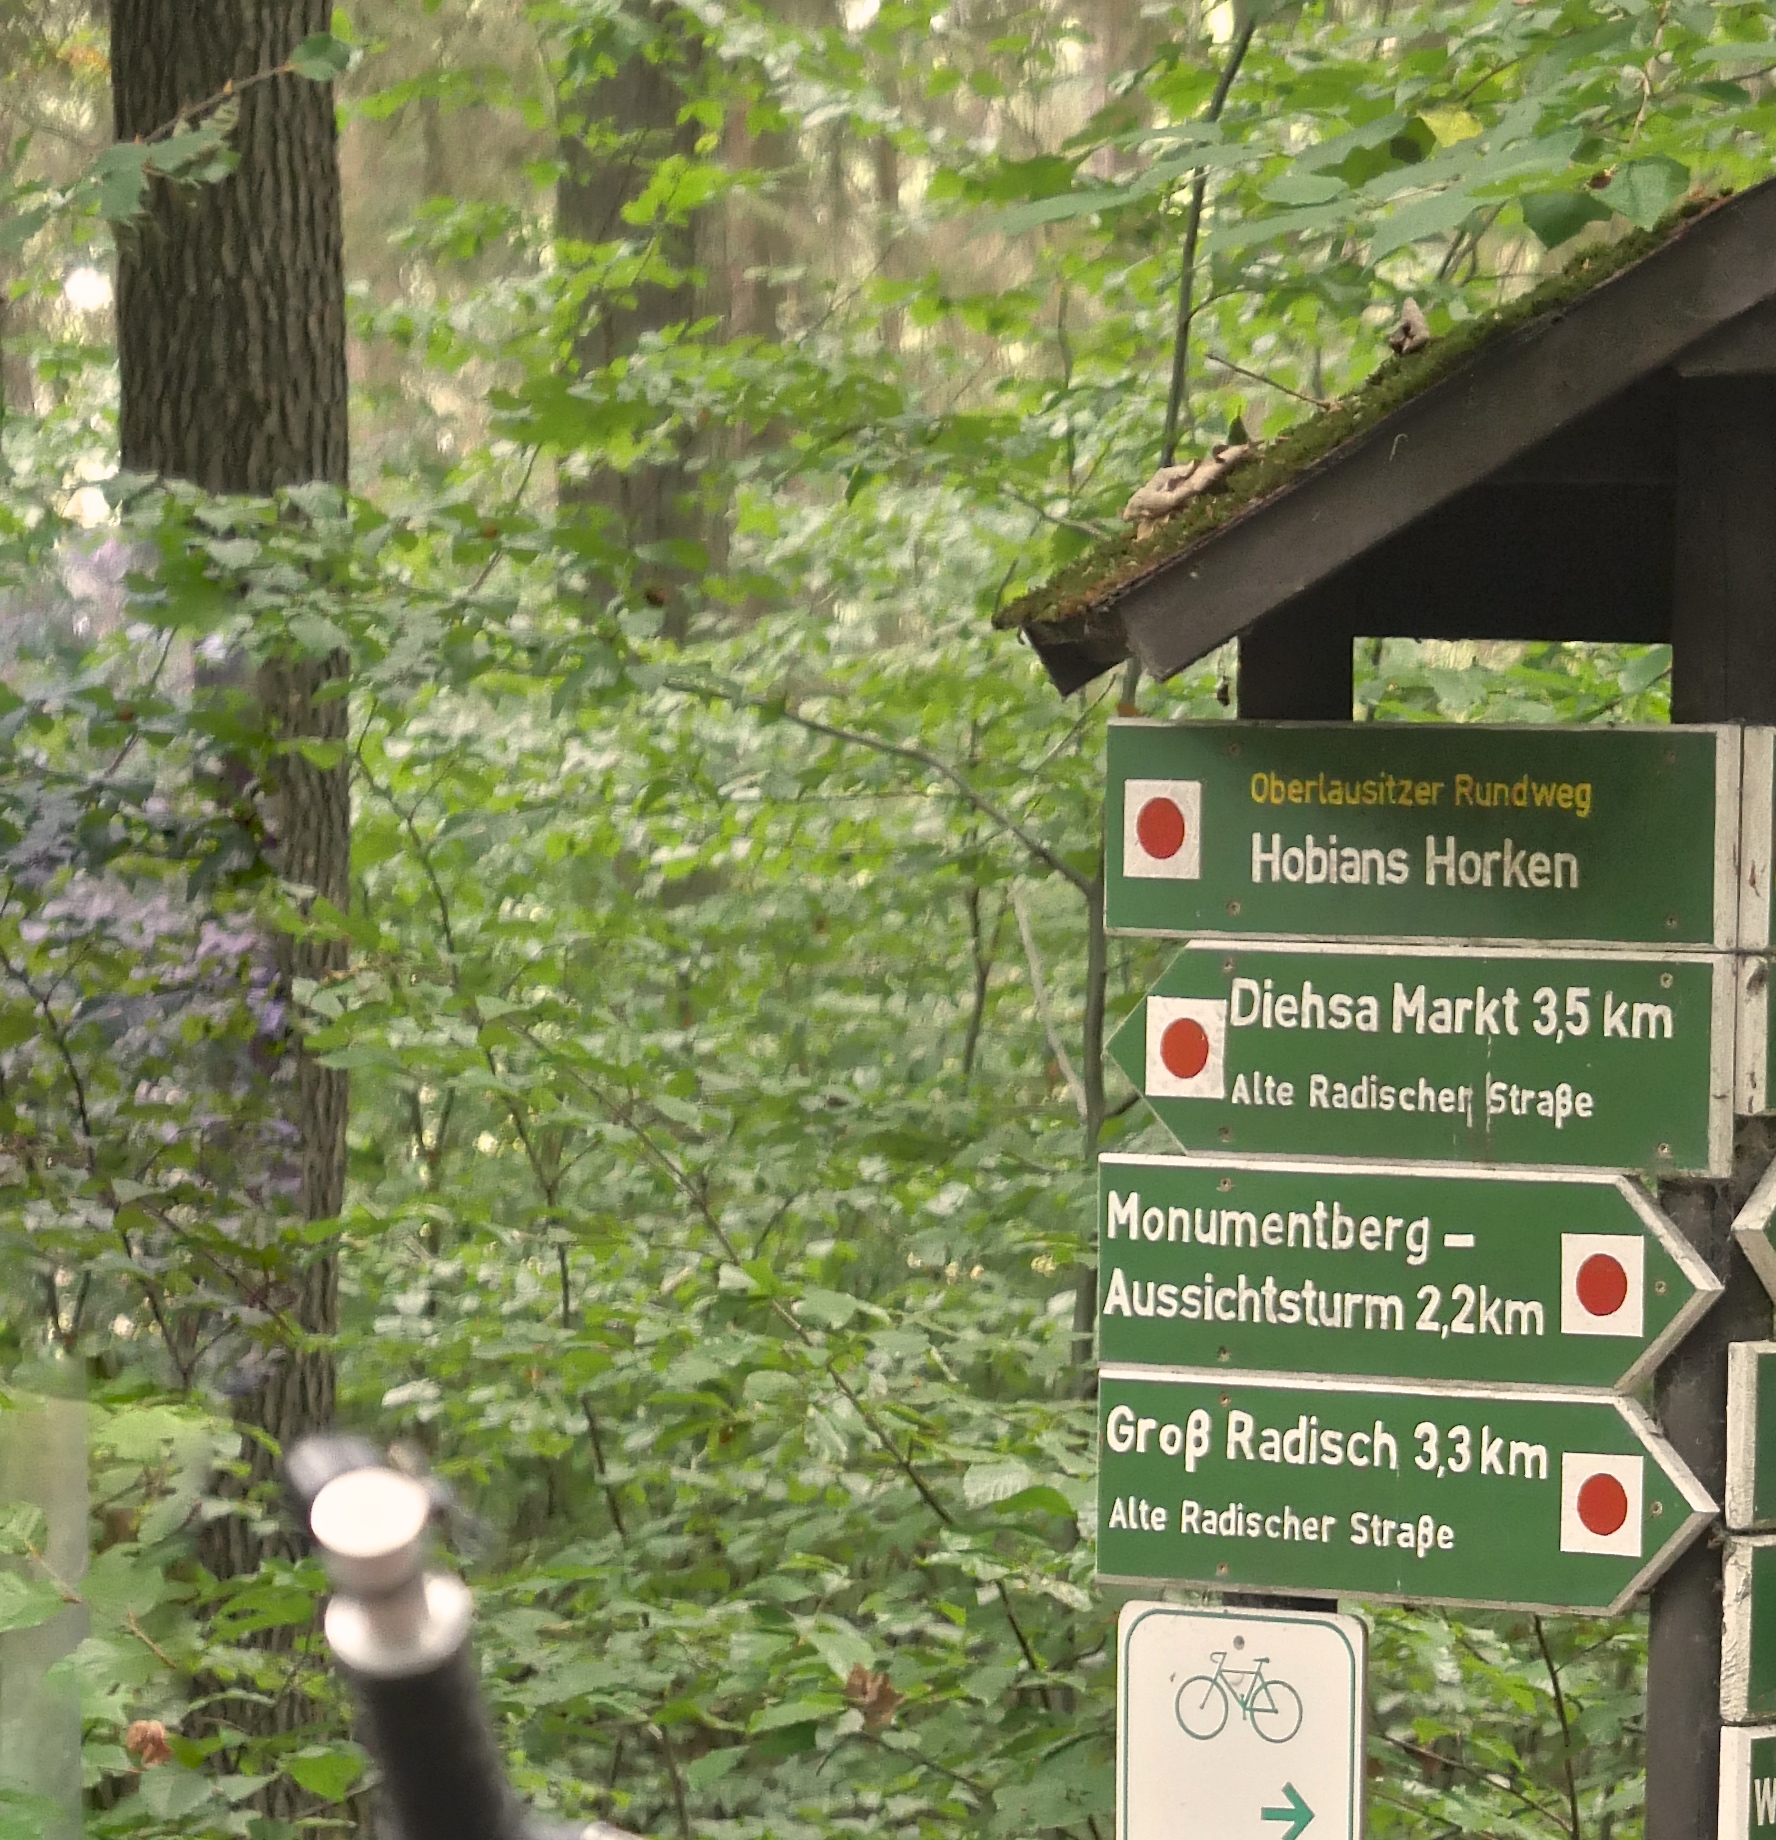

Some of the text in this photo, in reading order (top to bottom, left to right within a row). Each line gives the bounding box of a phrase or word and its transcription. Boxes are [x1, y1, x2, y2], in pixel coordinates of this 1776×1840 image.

[1251, 773, 1592, 817] Oberlausitzer Rundweg
[1251, 832, 1579, 889] Hobians Horken
[1230, 977, 1672, 1045] Diehsa Markt 3,5 km
[1232, 1072, 1294, 1107] Alte
[1310, 1074, 1473, 1115] Radischer
[1106, 1191, 1430, 1266] Monumentberg
[1103, 1268, 1403, 1331] Aussichtsturm
[1106, 1405, 1209, 1473] Groß
[1226, 1409, 1398, 1471] Radisch
[1415, 1422, 1472, 1479] 3,3
[1109, 1497, 1455, 1558] Alte Radischer Straße
